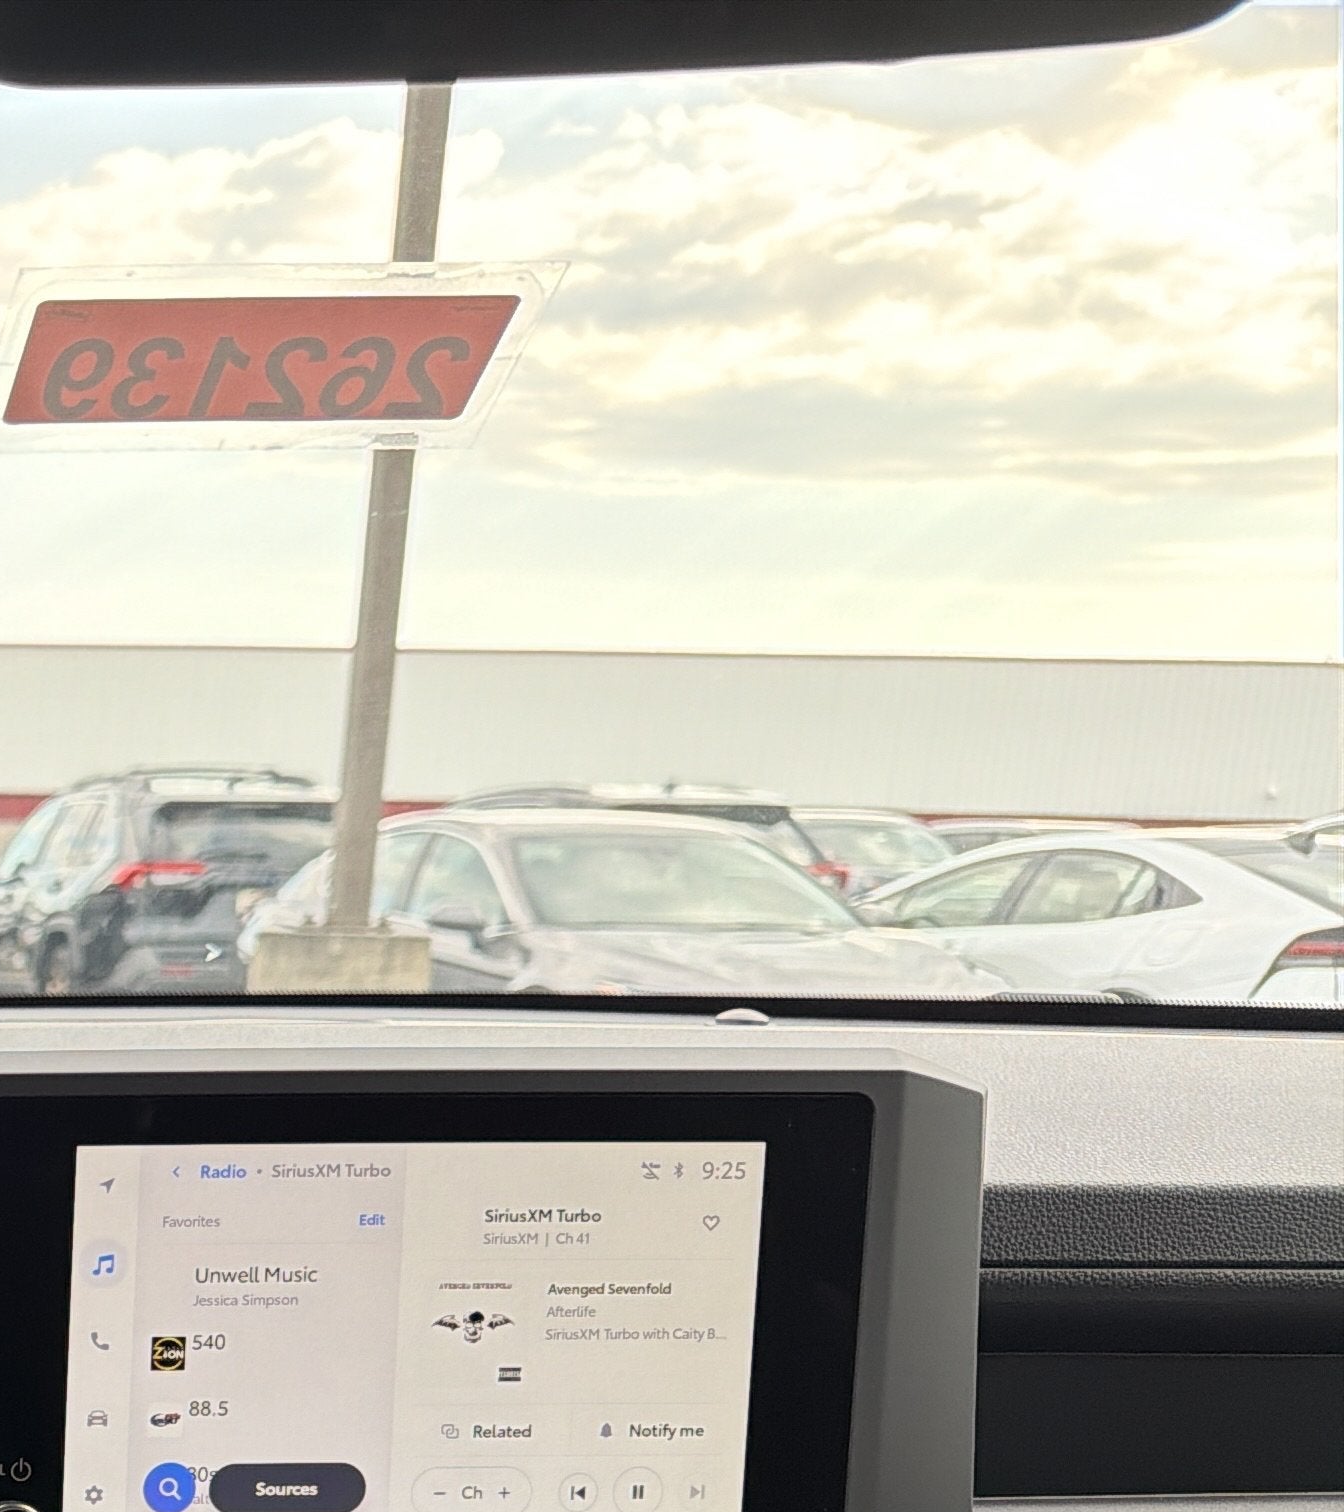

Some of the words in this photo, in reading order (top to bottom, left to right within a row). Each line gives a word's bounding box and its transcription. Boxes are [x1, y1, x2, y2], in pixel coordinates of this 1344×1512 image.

[200, 1164, 247, 1179] Radio
[271, 1163, 342, 1179] SiriusXM
[345, 1163, 392, 1179] Turbo
[701, 1161, 747, 1180] 9:25
[162, 1214, 221, 1229] Favorites
[358, 1213, 386, 1227] Edit
[484, 1209, 553, 1224] SiriusXM
[556, 1209, 602, 1224] Turbo
[483, 1232, 539, 1246] SiriusXM
[555, 1232, 574, 1245] Ch
[575, 1232, 591, 1245] 41
[195, 1266, 260, 1284] Unwell
[263, 1266, 318, 1284] Music
[548, 1284, 605, 1299] Avenged
[607, 1282, 672, 1296] Sevenfold
[192, 1293, 239, 1307] Jessica
[241, 1293, 299, 1309] Simpson
[546, 1306, 597, 1319] Afterlife
[191, 1334, 226, 1351] 540
[545, 1328, 600, 1342] SiriusXM
[604, 1328, 641, 1341] Turbo
[642, 1328, 670, 1341] with
[672, 1328, 705, 1344] Caity
[189, 1401, 229, 1416] 88.5
[472, 1425, 533, 1439] Related
[629, 1424, 677, 1441] Notify
[679, 1427, 705, 1438] me
[255, 1483, 318, 1497] Sources
[461, 1486, 483, 1500] Ch
